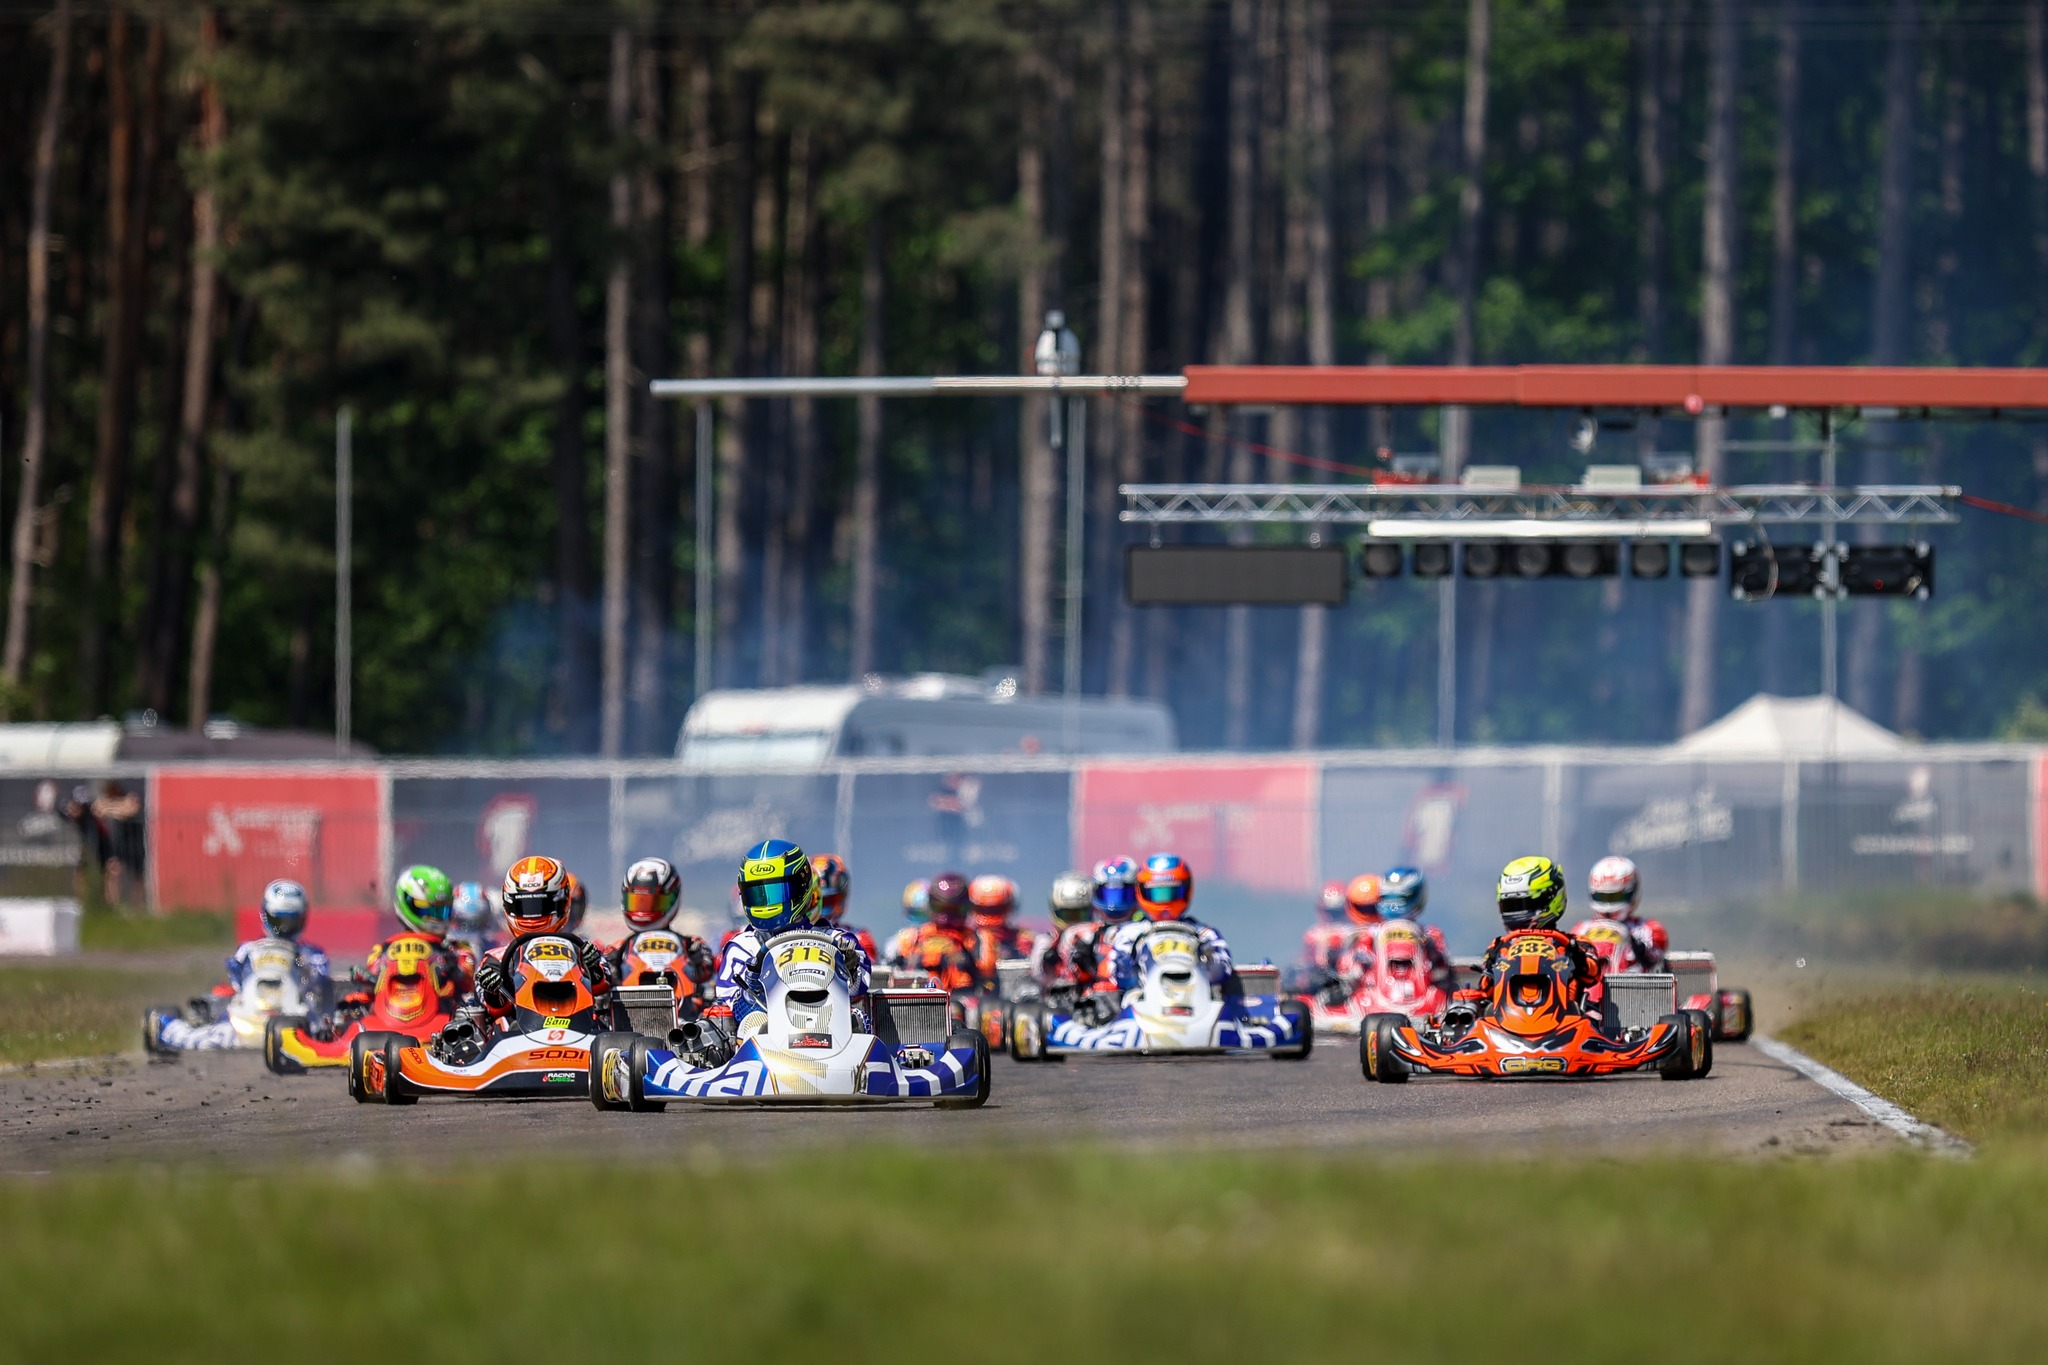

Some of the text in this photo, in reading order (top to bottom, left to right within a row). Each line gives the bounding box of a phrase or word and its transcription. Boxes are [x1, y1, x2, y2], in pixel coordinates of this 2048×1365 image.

[526, 944, 574, 962] 330
[1510, 942, 1554, 957] 332
[779, 947, 833, 968] 315
[545, 1016, 570, 1027] Sam
[406, 1046, 424, 1065] SODI
[528, 1049, 586, 1061] SODI
[1505, 1059, 1561, 1071] CRG
